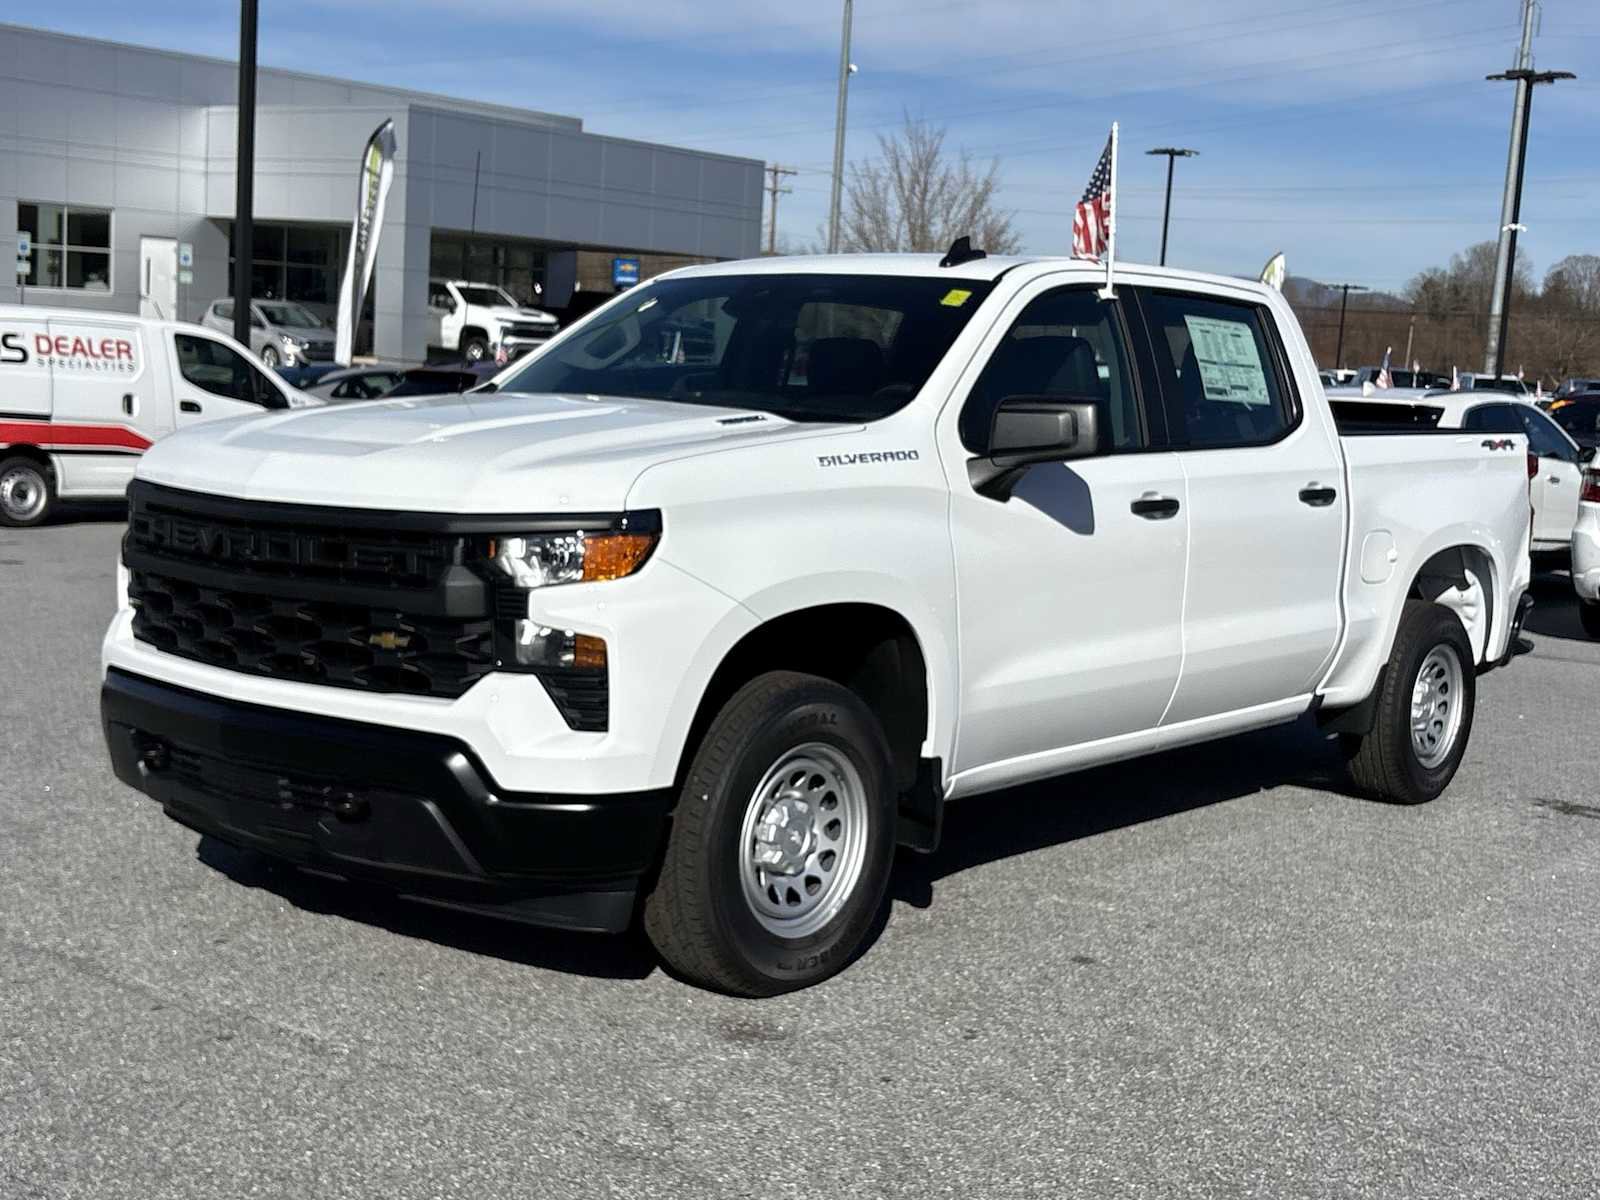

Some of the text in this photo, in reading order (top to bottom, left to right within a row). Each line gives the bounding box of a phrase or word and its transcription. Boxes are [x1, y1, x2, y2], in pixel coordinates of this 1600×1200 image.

[35, 333, 133, 360] DEALER
[37, 357, 135, 373] SPECIALTIES
[817, 449, 919, 467] SILVERADO
